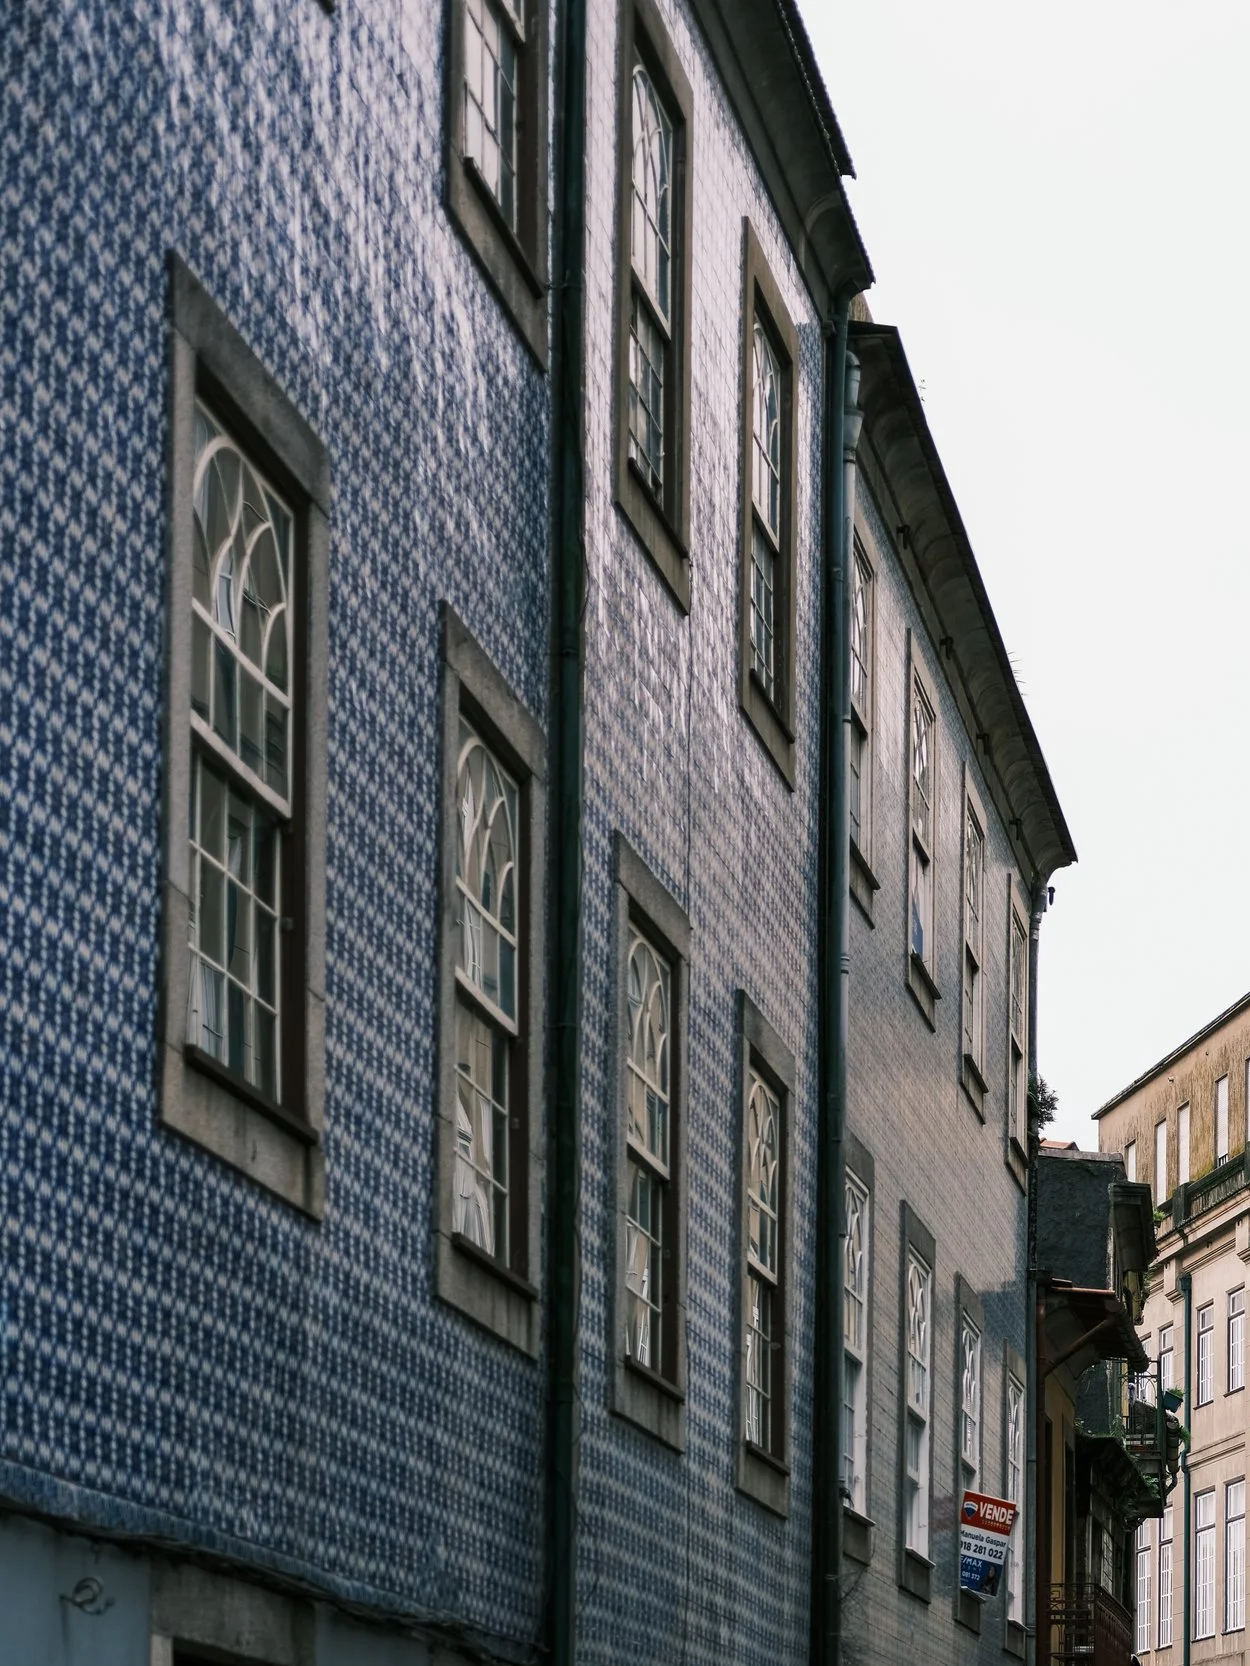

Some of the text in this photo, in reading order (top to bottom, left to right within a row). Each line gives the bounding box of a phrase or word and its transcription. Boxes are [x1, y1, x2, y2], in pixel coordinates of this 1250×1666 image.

[980, 1502, 1014, 1525] VENDE
[985, 1537, 1006, 1548] Gaspar
[973, 1544, 987, 1555] 281
[988, 1549, 1003, 1560] 022
